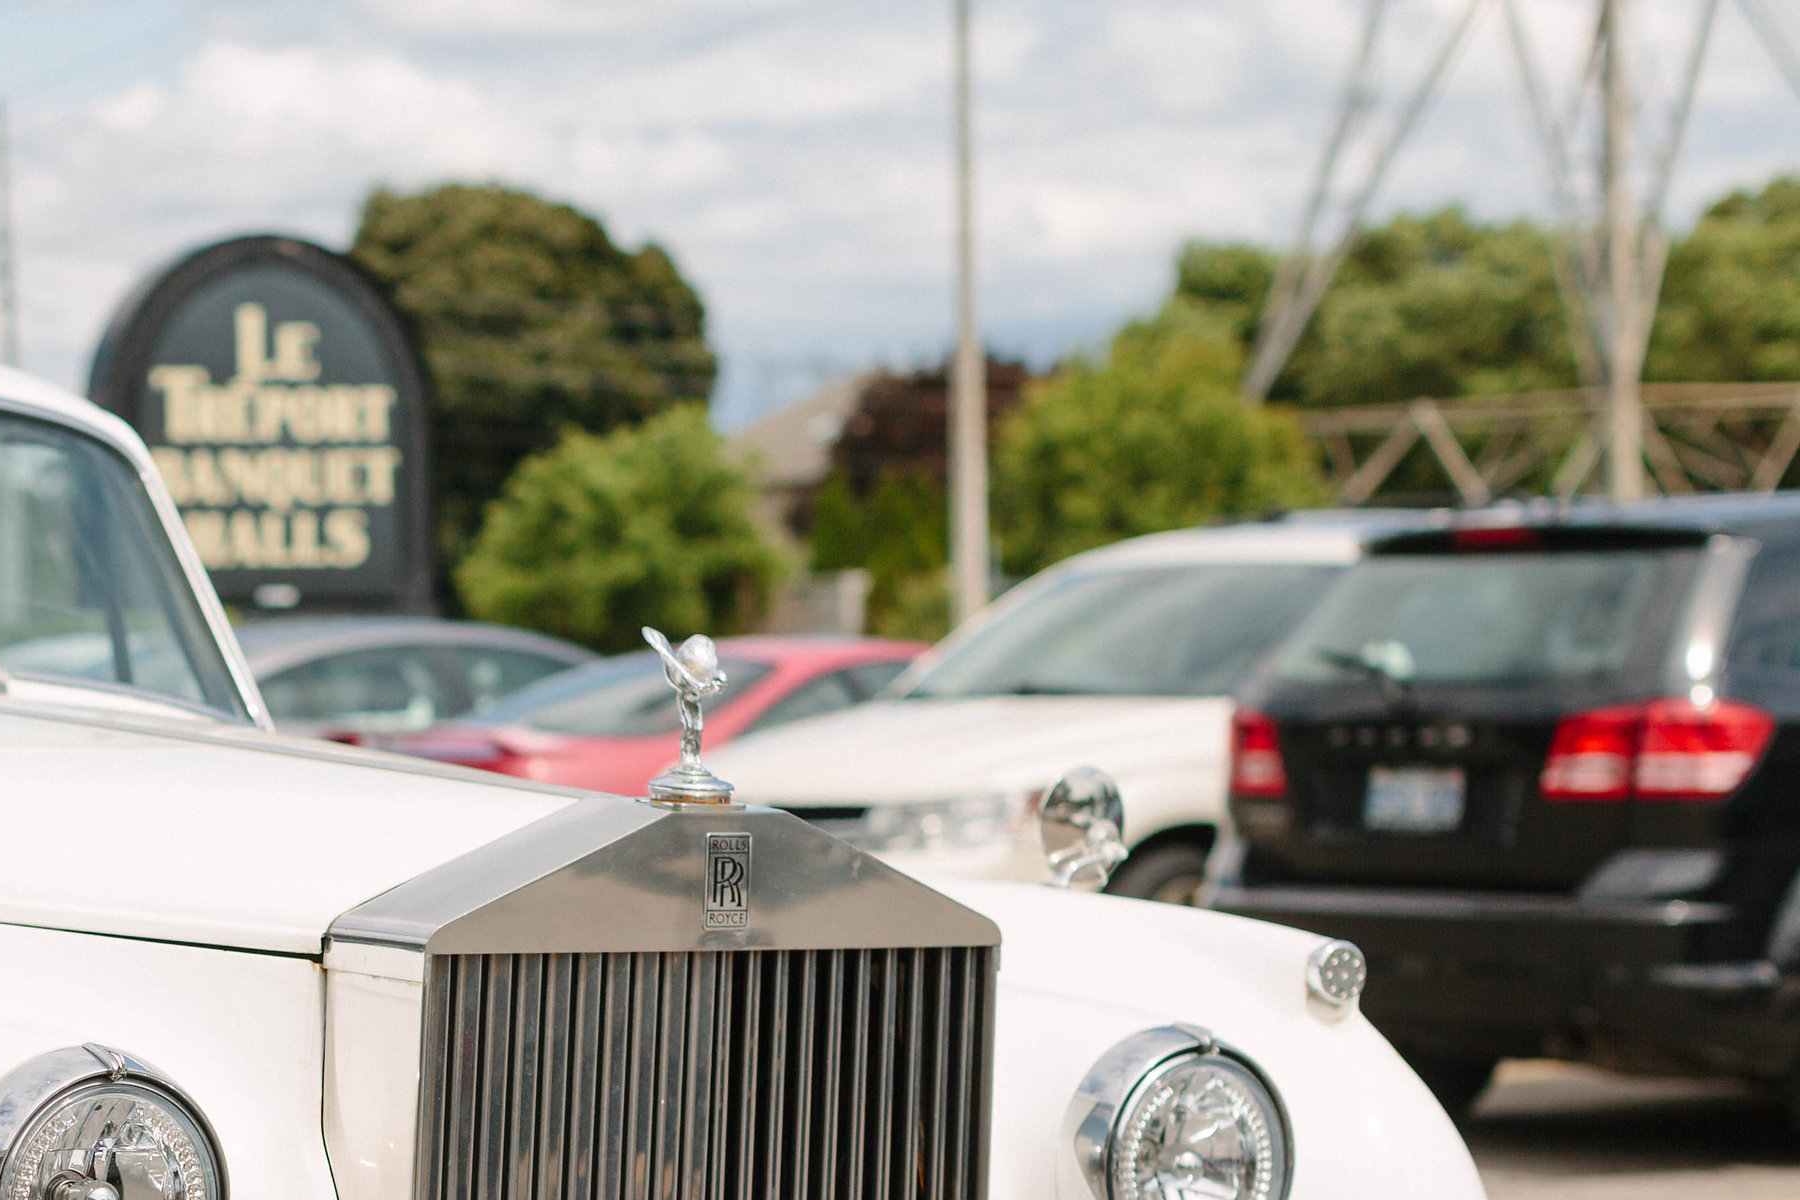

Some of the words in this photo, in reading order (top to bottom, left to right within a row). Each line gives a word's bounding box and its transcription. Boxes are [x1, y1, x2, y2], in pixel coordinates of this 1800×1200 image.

[234, 301, 321, 382] LE
[149, 445, 403, 514] BANQUET
[182, 507, 370, 569] HALLS
[711, 839, 747, 851] ROLLS
[712, 856, 744, 907] RR
[709, 913, 745, 924] ROYCE
